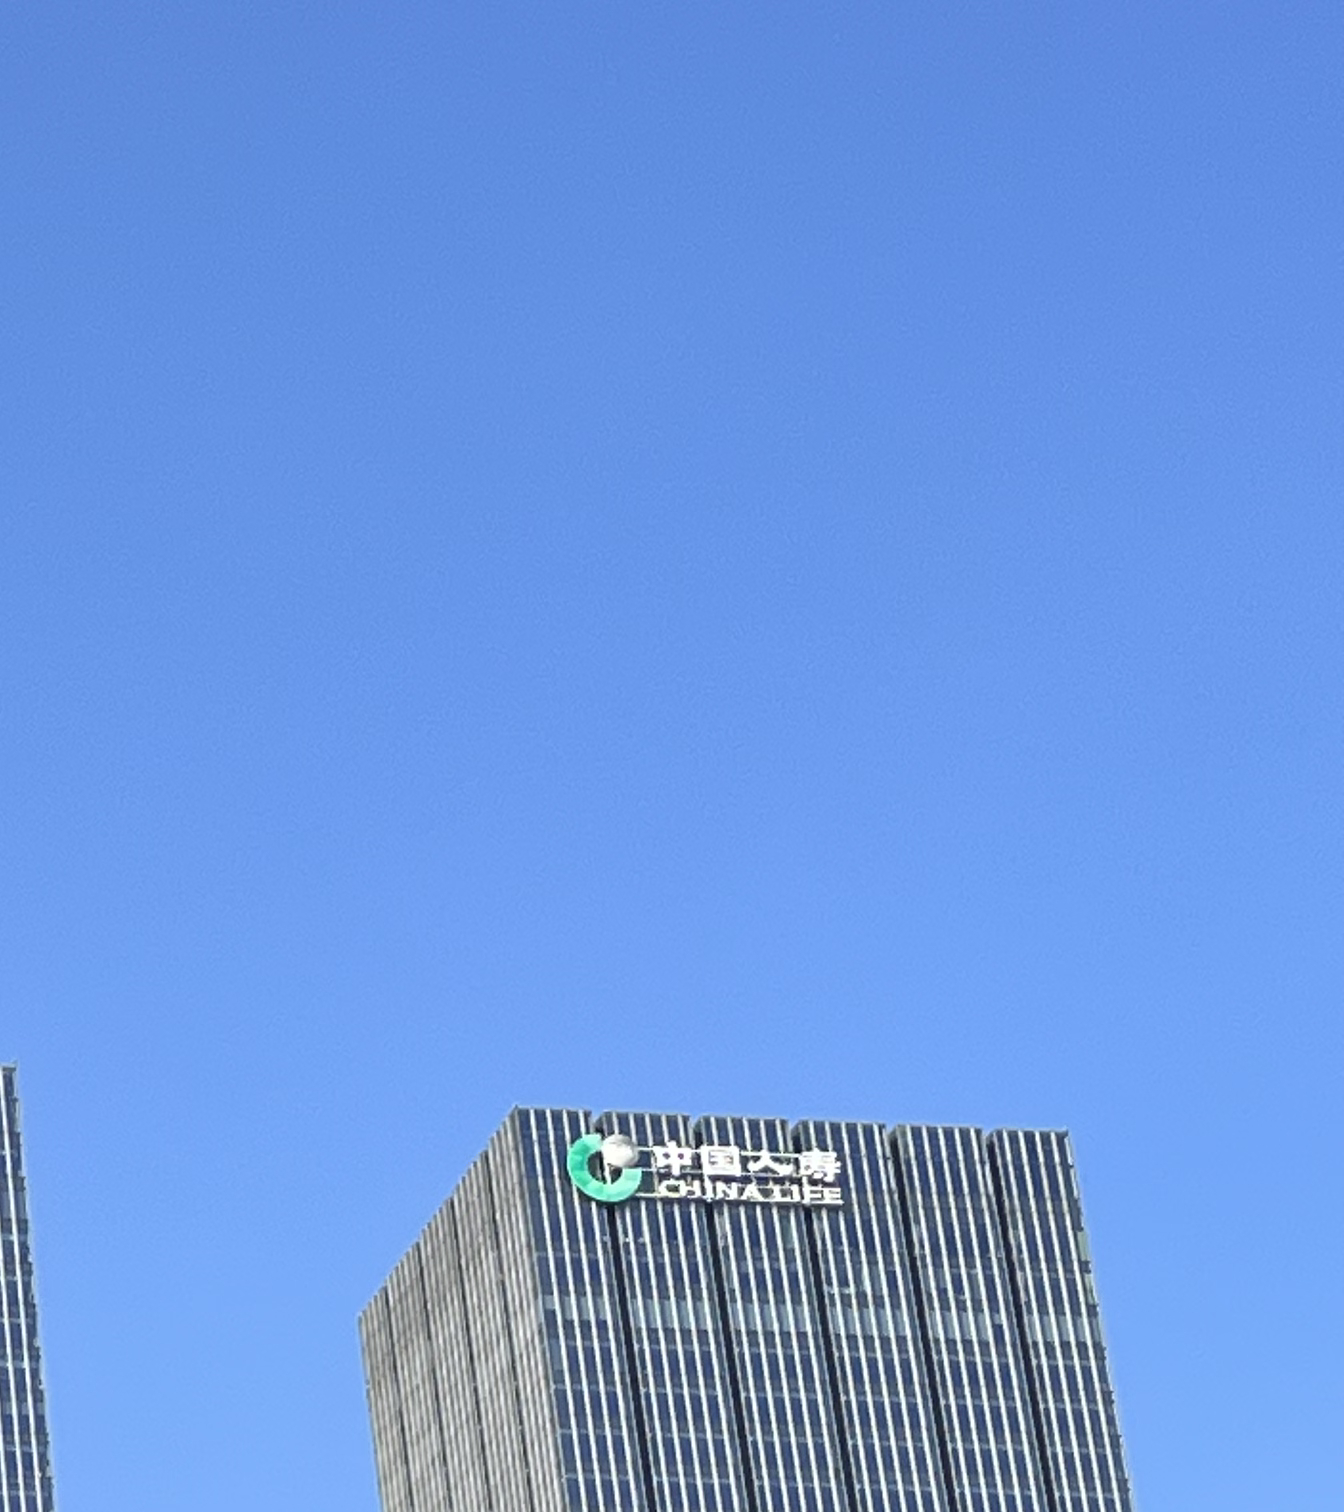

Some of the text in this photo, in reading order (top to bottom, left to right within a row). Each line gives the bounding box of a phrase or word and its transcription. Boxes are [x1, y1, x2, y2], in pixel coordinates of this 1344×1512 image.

[652, 1141, 841, 1182] 中国人寿
[659, 1179, 843, 1205] CHINA LIFE
